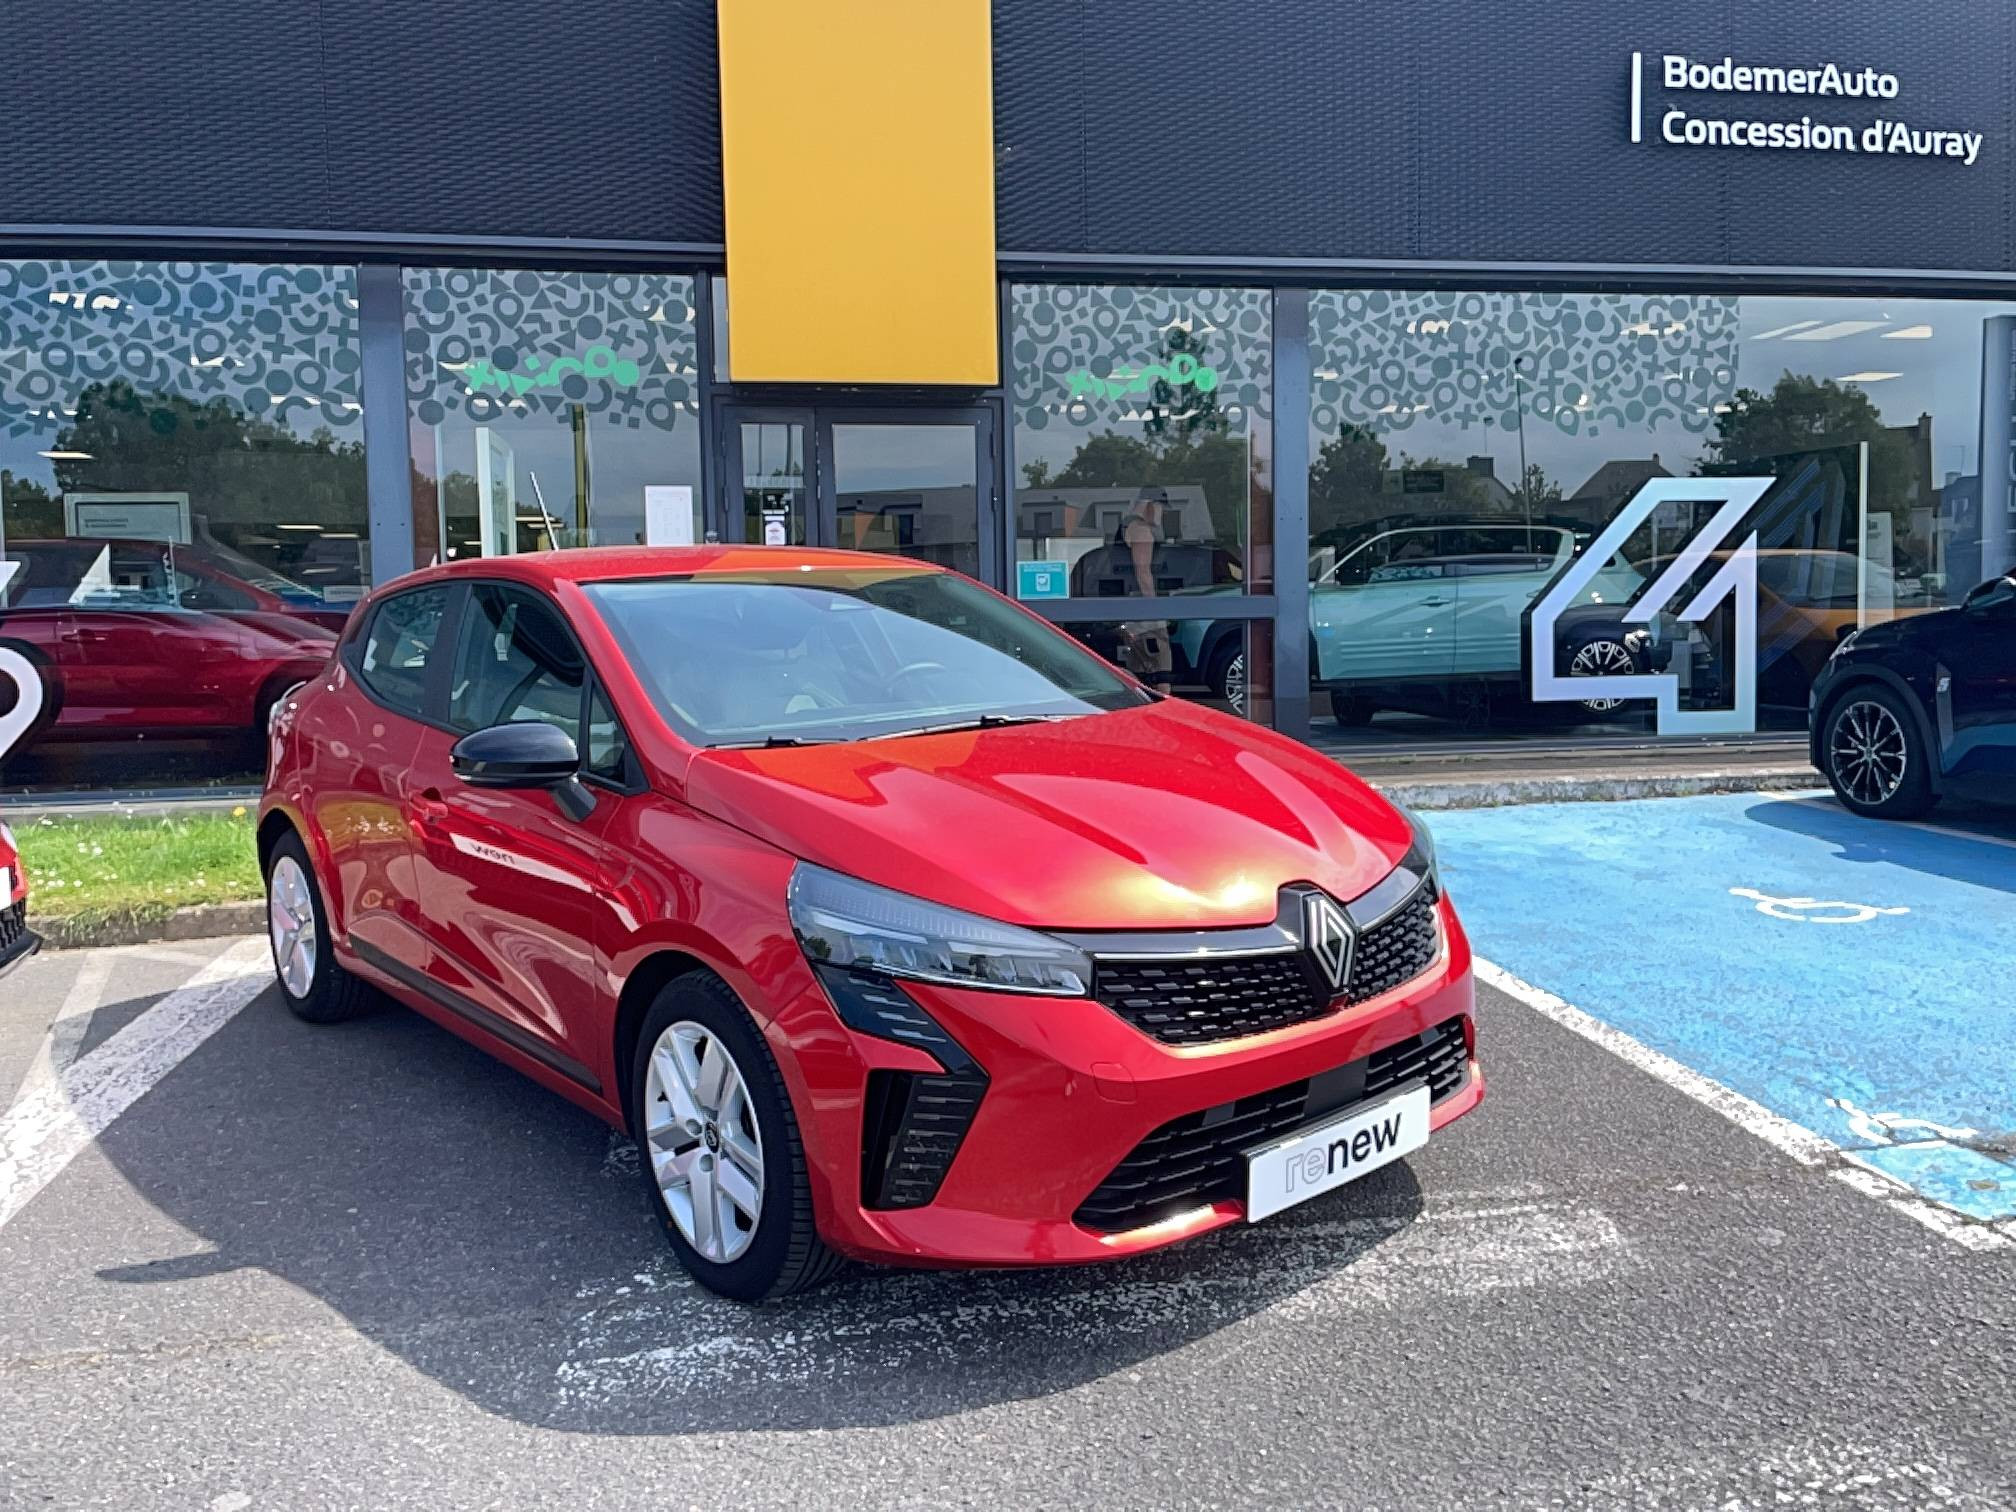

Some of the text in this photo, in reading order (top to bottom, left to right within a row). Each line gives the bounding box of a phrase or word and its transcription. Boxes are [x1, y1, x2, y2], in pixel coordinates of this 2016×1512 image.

[1662, 55, 1899, 98] BodemerAuto
[1662, 111, 1983, 166] Concession d'Auray
[1285, 1111, 1402, 1193] renew
